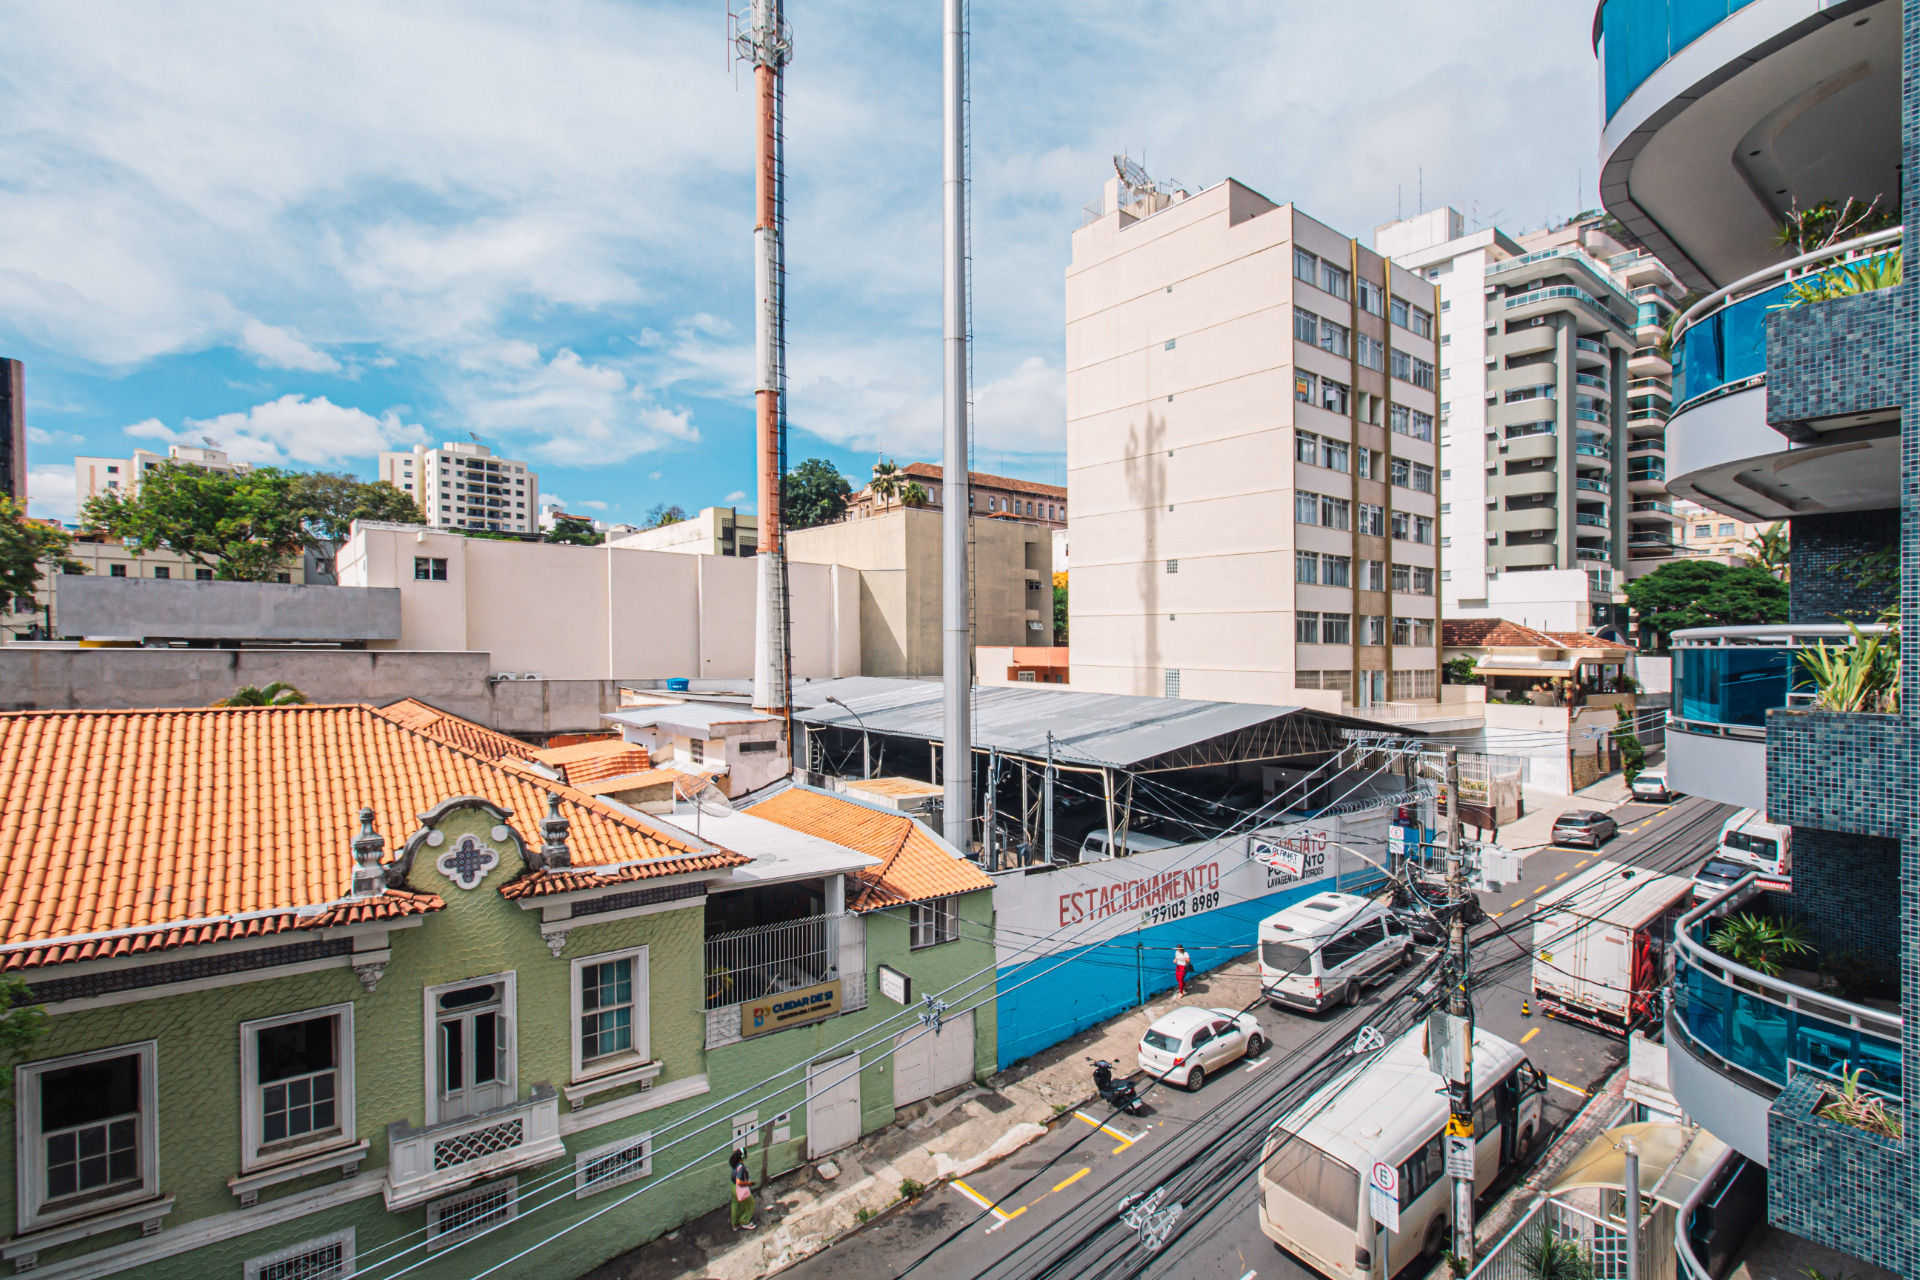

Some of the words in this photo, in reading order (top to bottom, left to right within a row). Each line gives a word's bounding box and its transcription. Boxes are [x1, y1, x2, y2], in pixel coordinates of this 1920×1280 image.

[1272, 846, 1298, 861] PLANET
[1059, 862, 1219, 927] ESTACIONAMENTO
[1151, 900, 1186, 924] 99103
[1192, 891, 1219, 913] 8989
[772, 996, 810, 1014] CUIDAR
[810, 992, 824, 1004] DE
[824, 990, 833, 1000] SI
[1380, 1168, 1388, 1185] E
